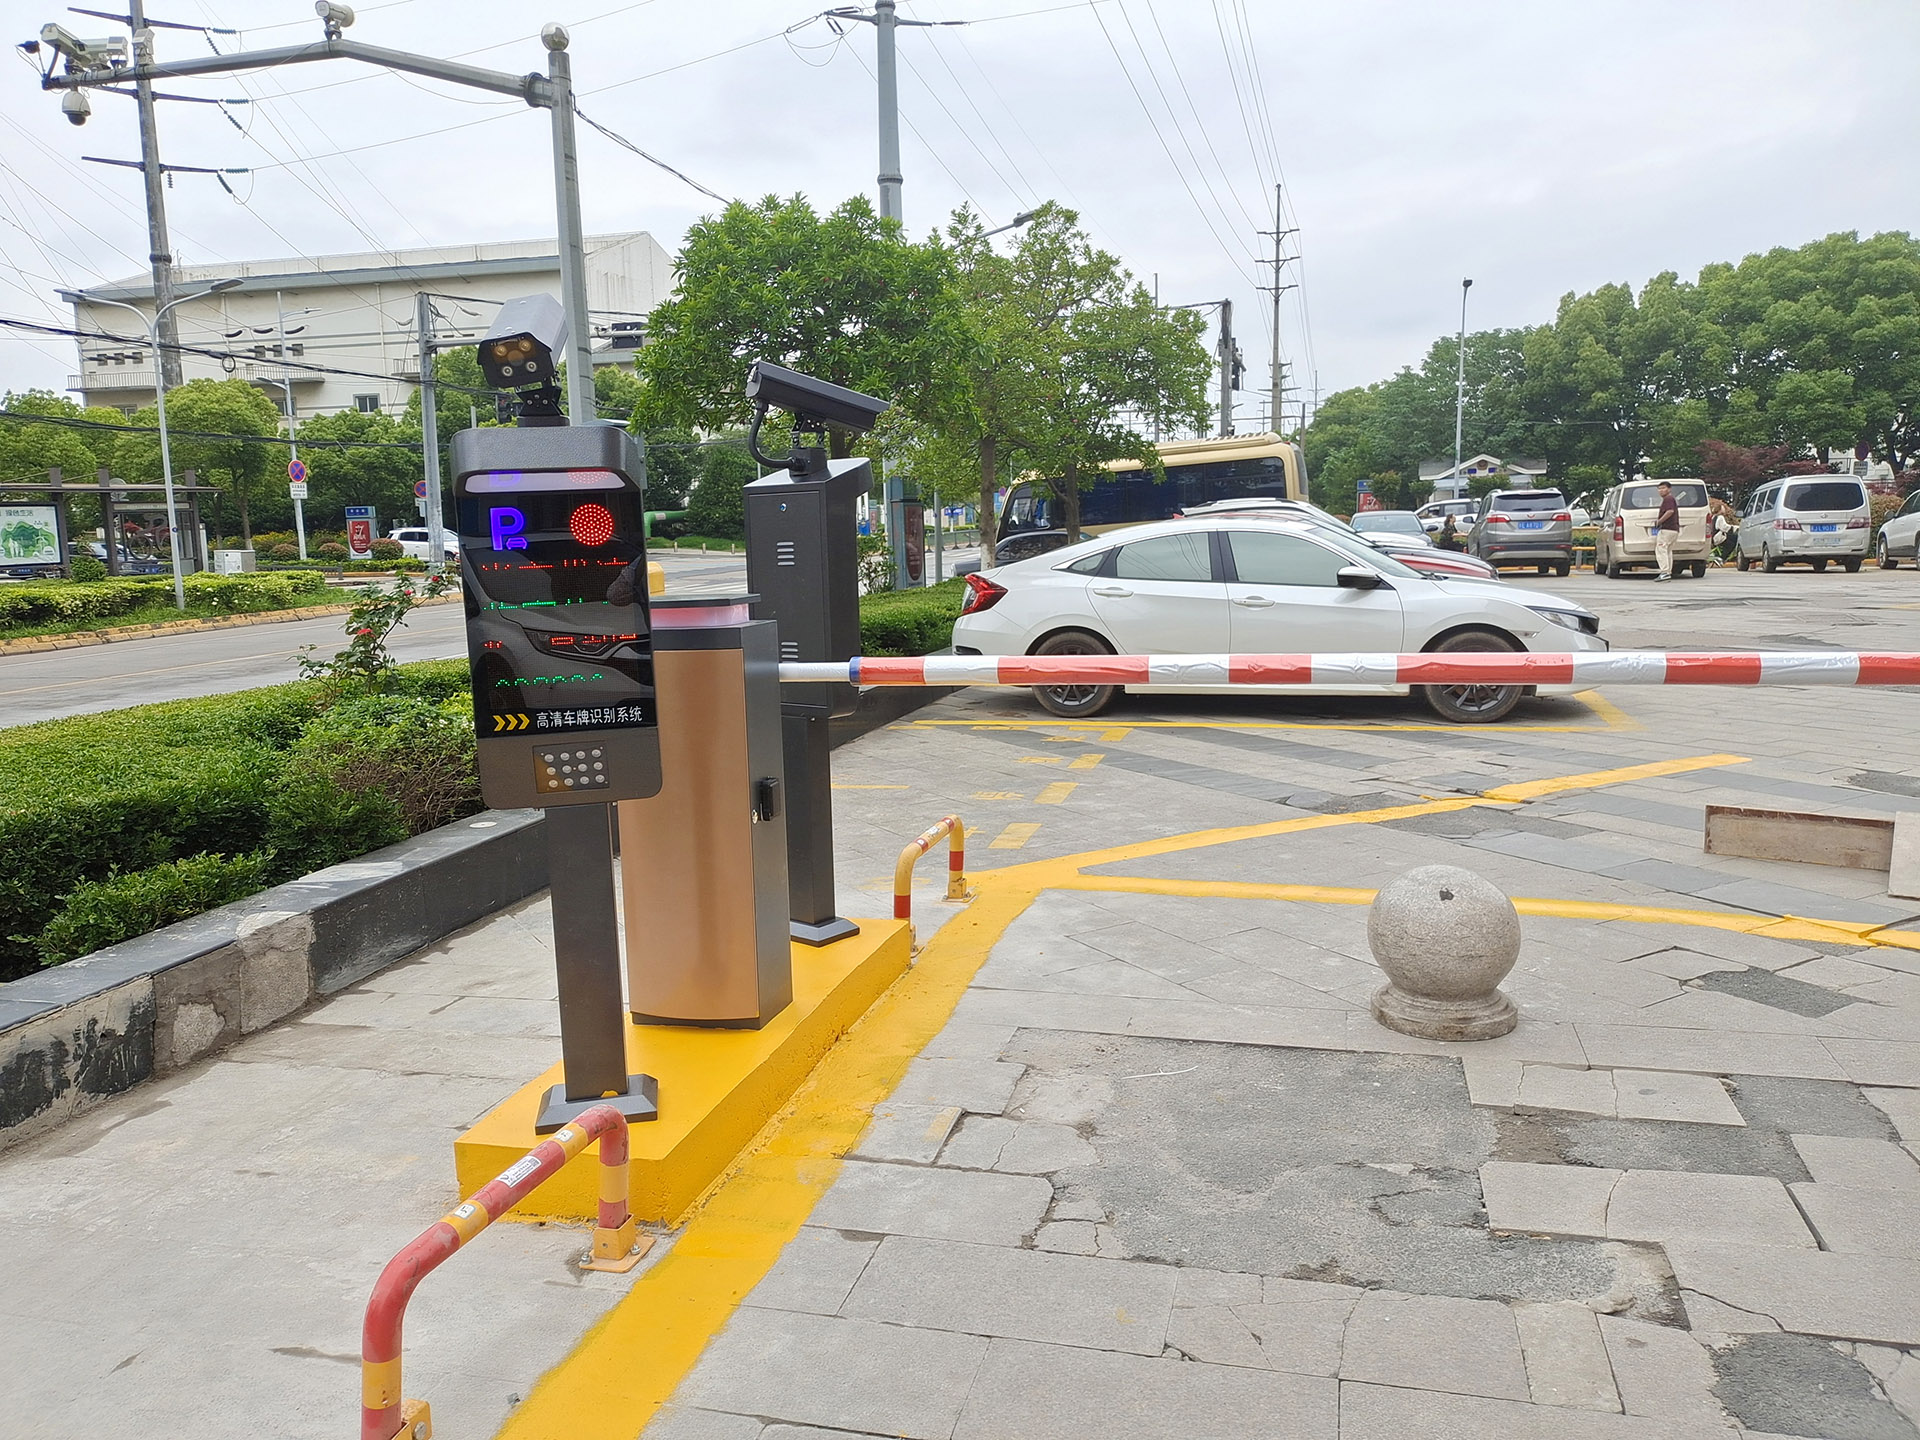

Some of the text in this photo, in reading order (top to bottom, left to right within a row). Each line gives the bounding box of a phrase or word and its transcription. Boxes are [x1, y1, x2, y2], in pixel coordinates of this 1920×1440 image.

[490, 507, 525, 550] P
[536, 705, 643, 729] 高清车牌识别系统
